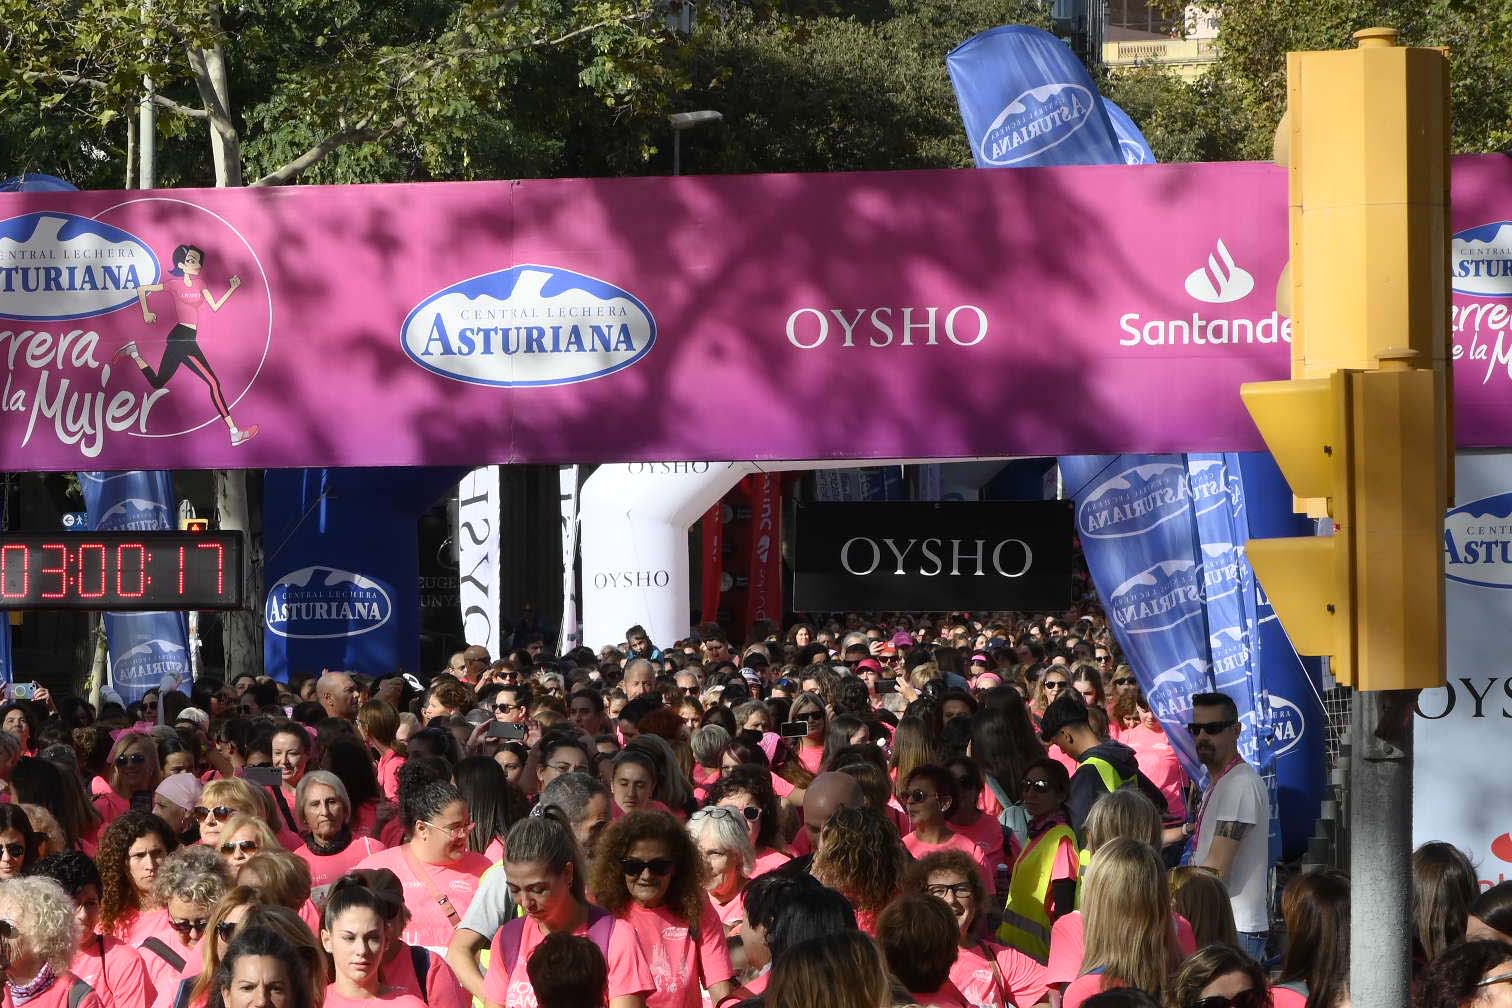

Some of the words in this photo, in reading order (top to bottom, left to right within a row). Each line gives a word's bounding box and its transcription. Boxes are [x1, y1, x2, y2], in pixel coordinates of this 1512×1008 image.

[63, 248, 137, 260] LECHERA
[460, 306, 541, 321] CENTRAL
[547, 305, 629, 319] LECHERA
[785, 304, 989, 349] OYSHO
[1119, 311, 1294, 346] Santande
[420, 311, 637, 357] ASTURIANA
[1469, 332, 1488, 360] la
[2, 373, 28, 413] la
[21, 363, 171, 459] Mujer
[627, 461, 710, 475] OYSHO
[1466, 526, 1512, 536] CENT
[1, 543, 223, 598] 03:00:17
[840, 537, 1034, 578] OYSHO
[593, 569, 670, 589] OYSHO
[269, 596, 382, 624] ASTURIANA
[282, 592, 323, 600] CENTRAL
[1413, 677, 1512, 720] OYS
